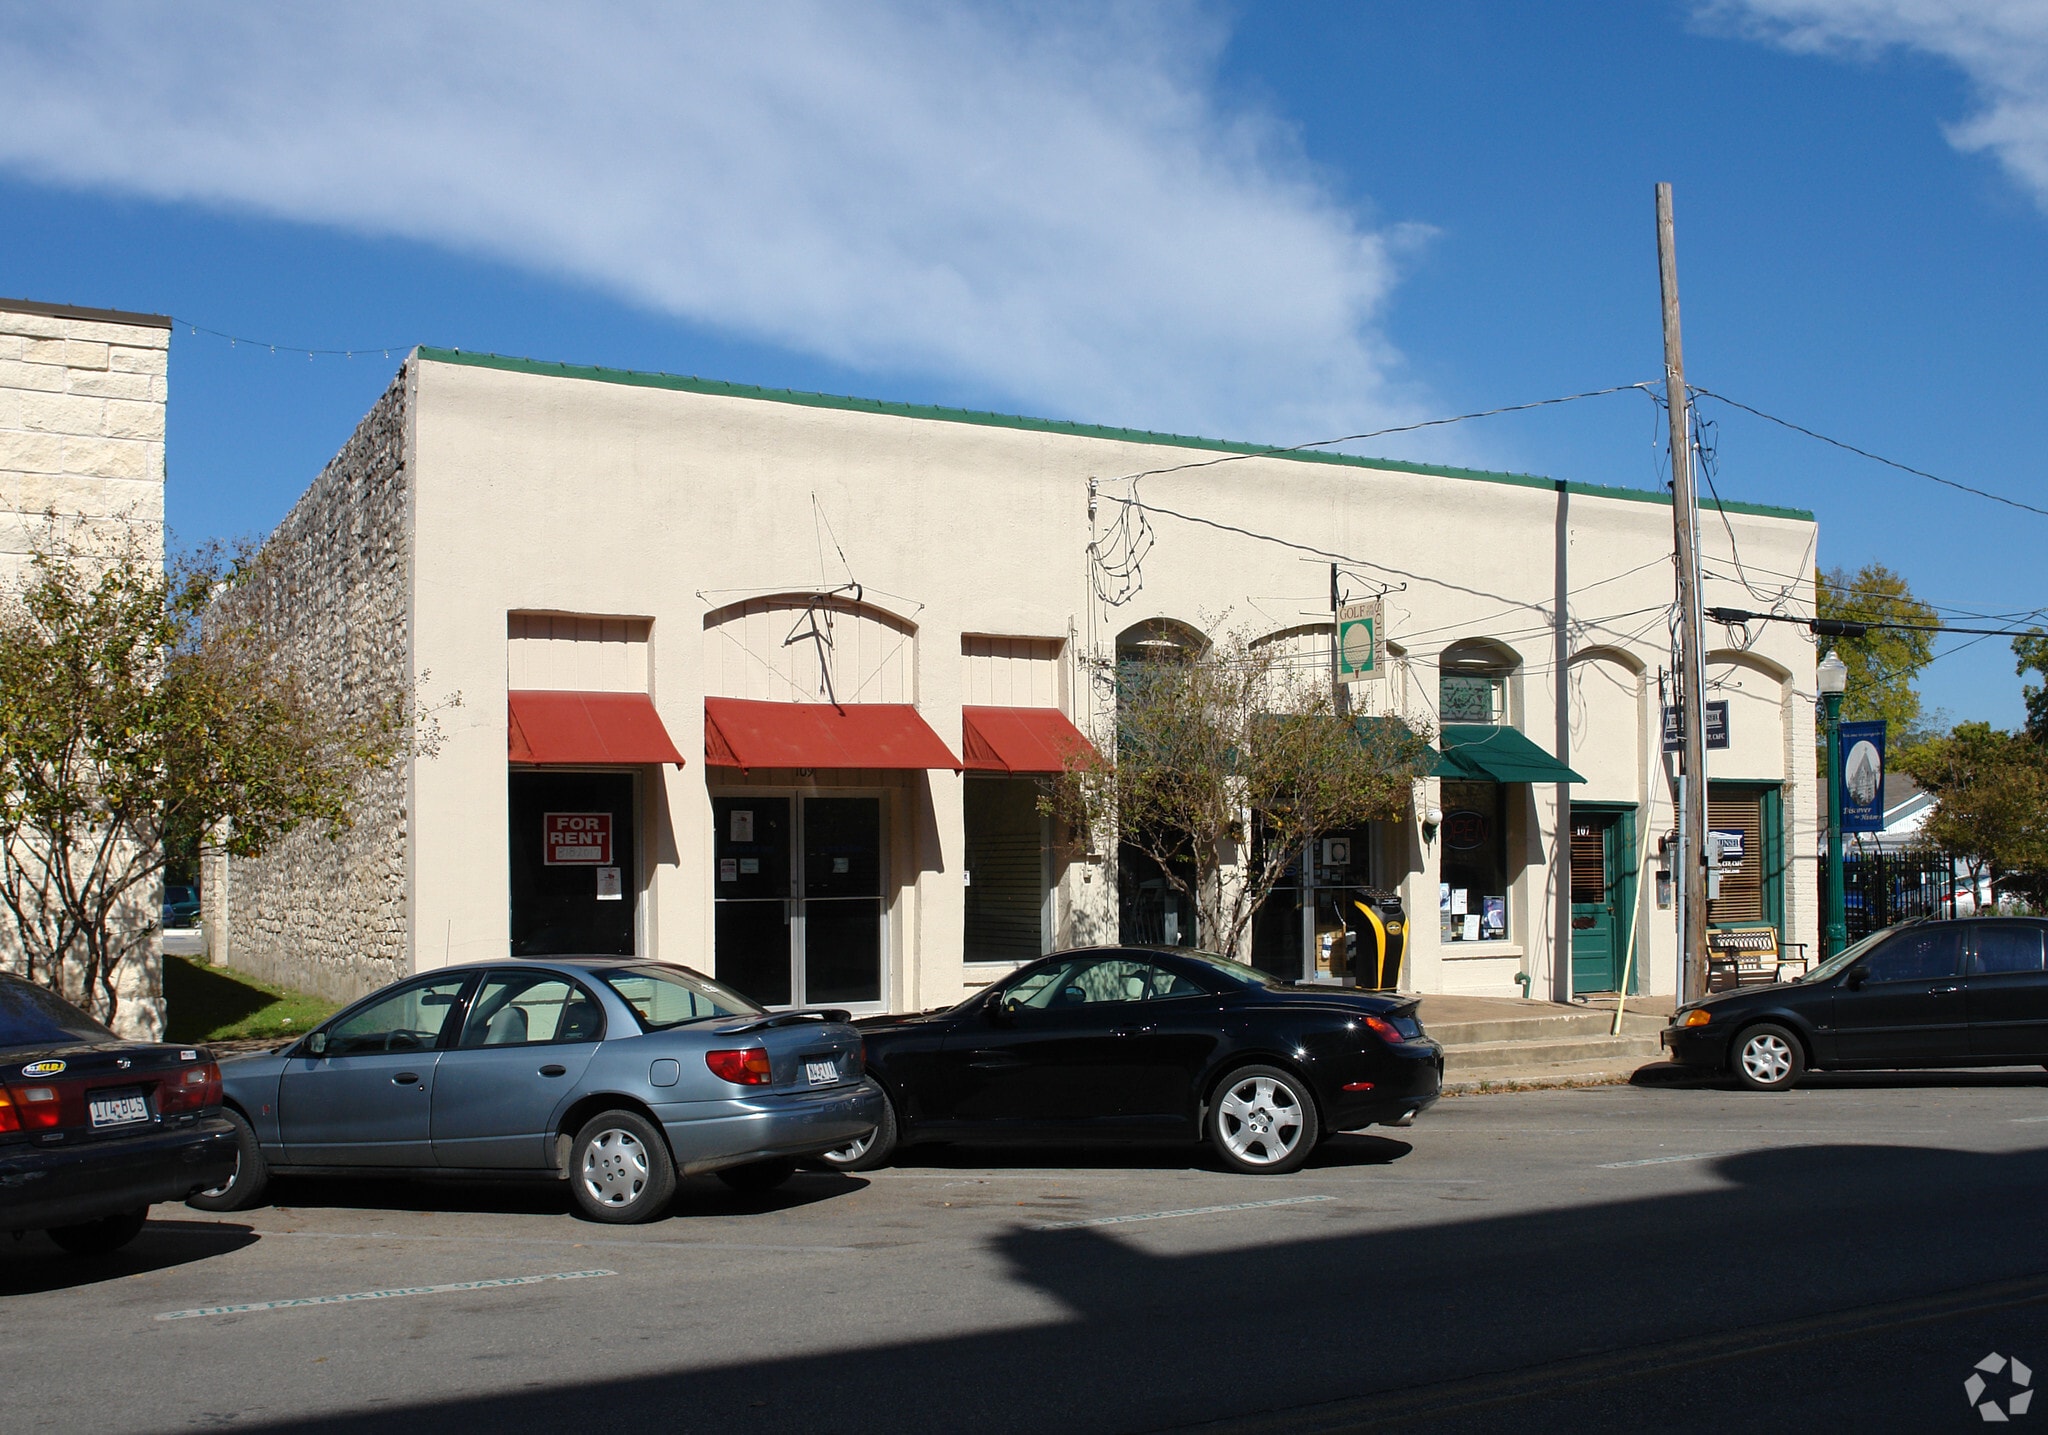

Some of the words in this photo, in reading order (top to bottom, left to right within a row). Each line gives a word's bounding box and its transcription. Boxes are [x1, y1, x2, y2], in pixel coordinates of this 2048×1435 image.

[1340, 605, 1365, 620] GOLF
[1375, 602, 1383, 672] SQUARE
[557, 817, 599, 830] FOR
[1577, 826, 1590, 836] 107
[550, 832, 607, 845] RENT
[169, 1311, 187, 1319] 2
[199, 1304, 250, 1316] HR
[266, 1287, 435, 1309] PARKING
